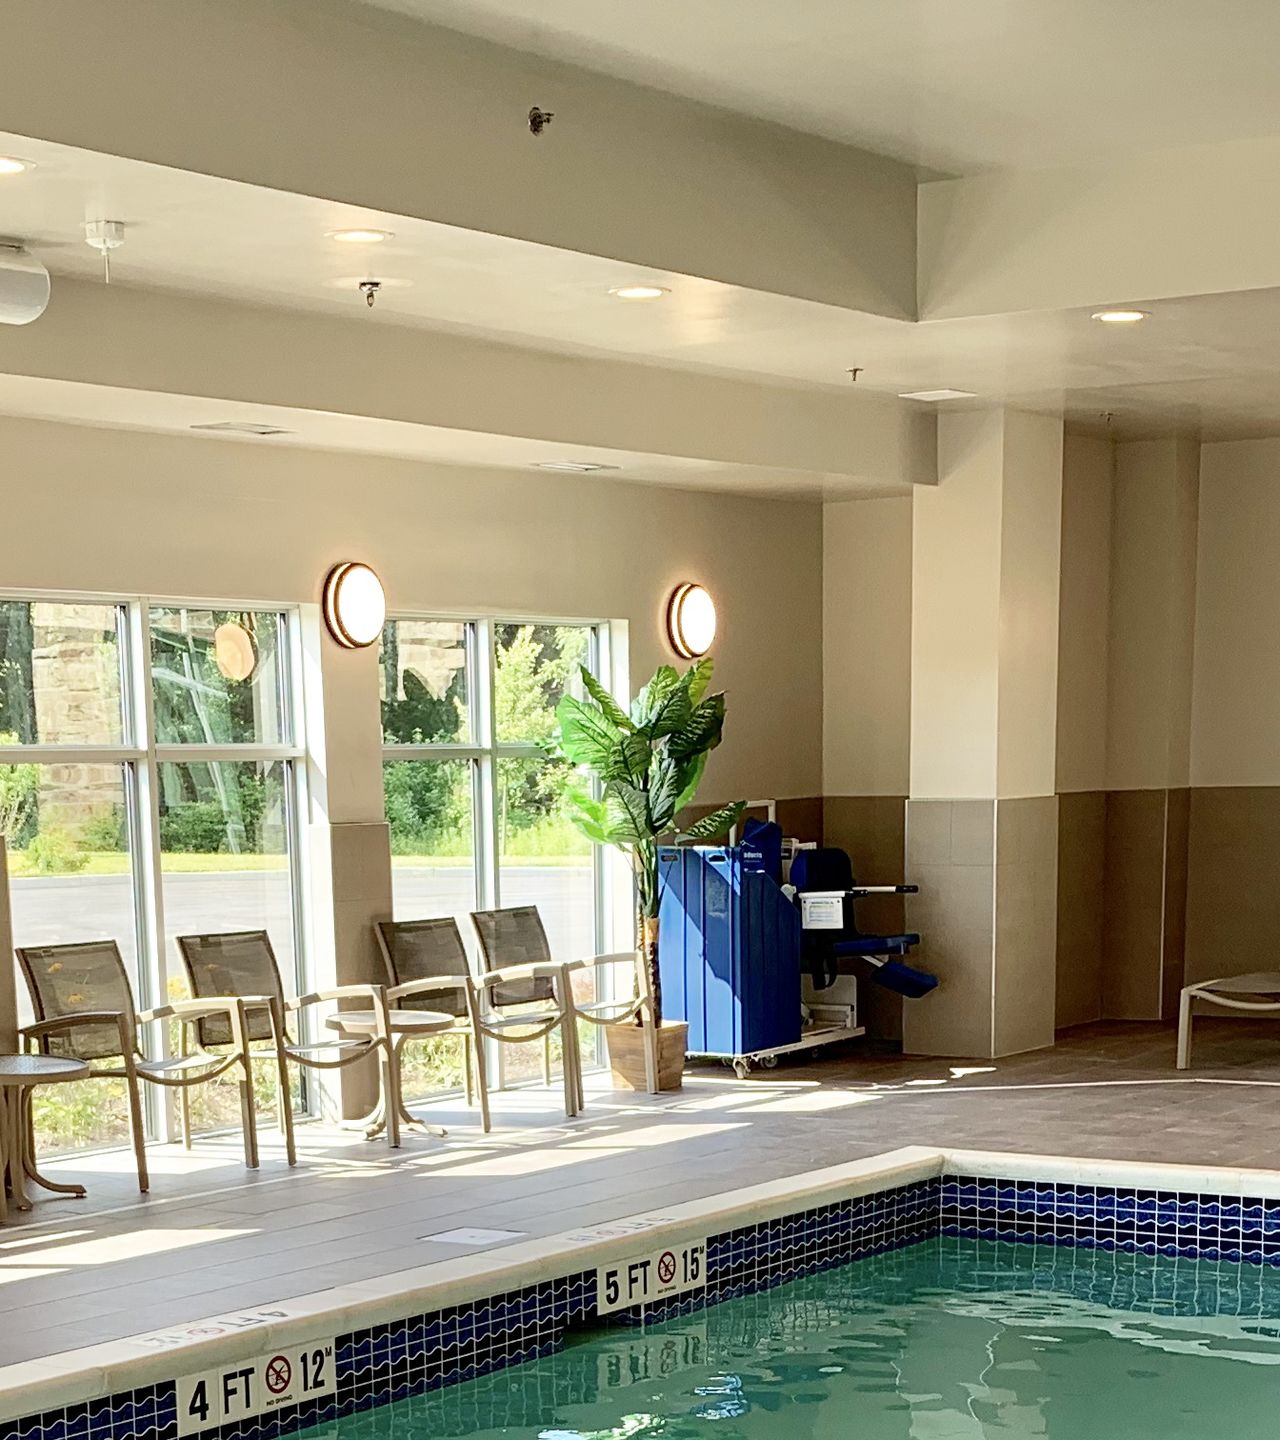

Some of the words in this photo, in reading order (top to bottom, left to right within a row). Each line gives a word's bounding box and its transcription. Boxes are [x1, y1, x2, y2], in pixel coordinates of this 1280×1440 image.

[605, 1269, 619, 1305] 5
[628, 1259, 651, 1300] FT
[189, 1380, 209, 1421] 4
[223, 1367, 255, 1414] FT
